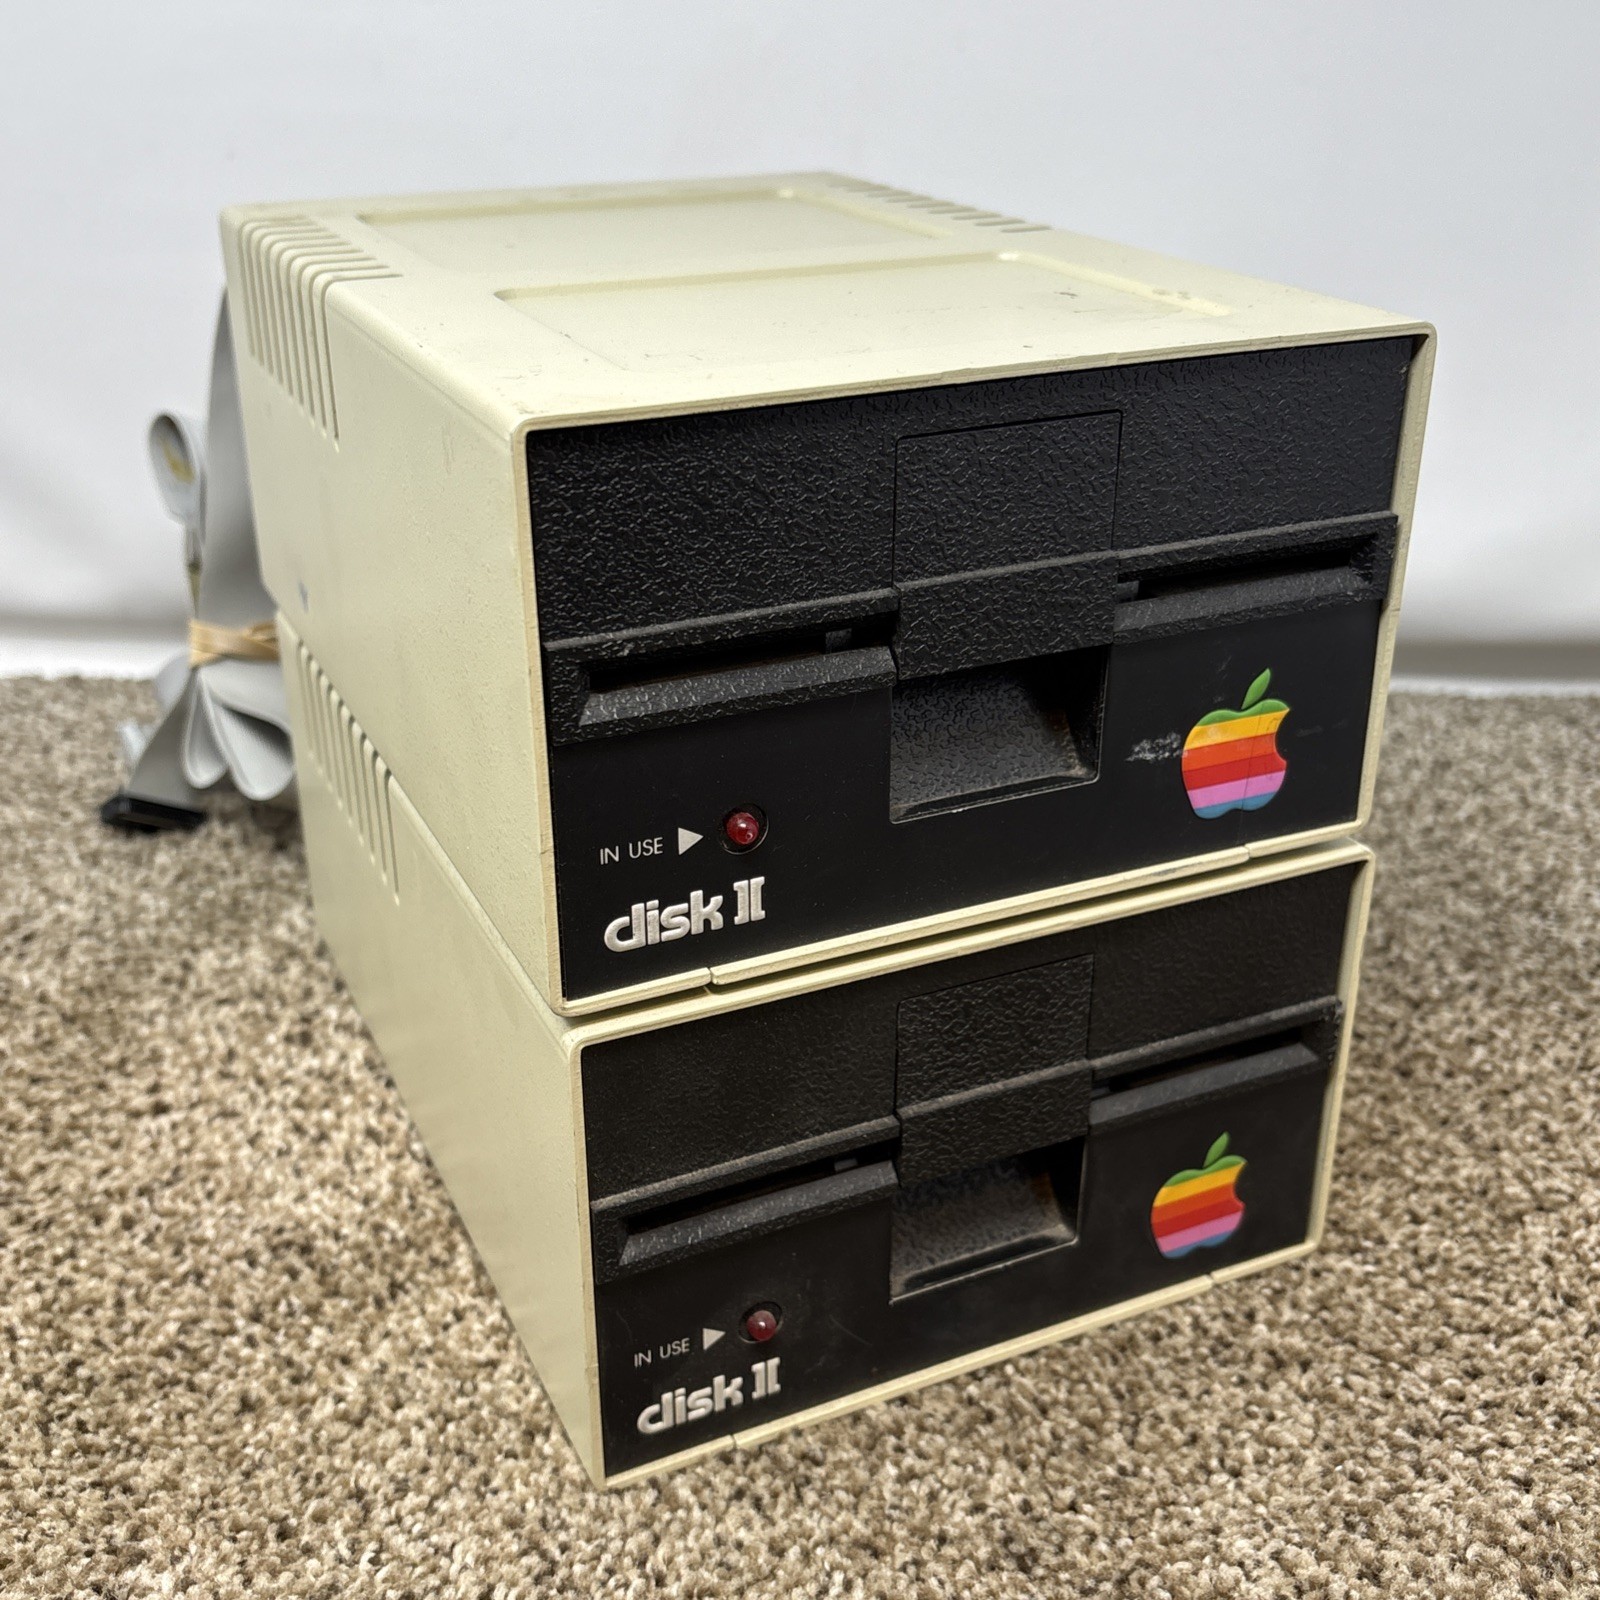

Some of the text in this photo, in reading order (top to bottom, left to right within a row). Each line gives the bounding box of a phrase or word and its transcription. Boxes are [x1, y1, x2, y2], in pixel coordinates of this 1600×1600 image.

[600, 837, 663, 865] IN USE
[603, 875, 766, 952] disk II
[633, 1337, 690, 1368] IN USE
[636, 1356, 782, 1434] disk II
